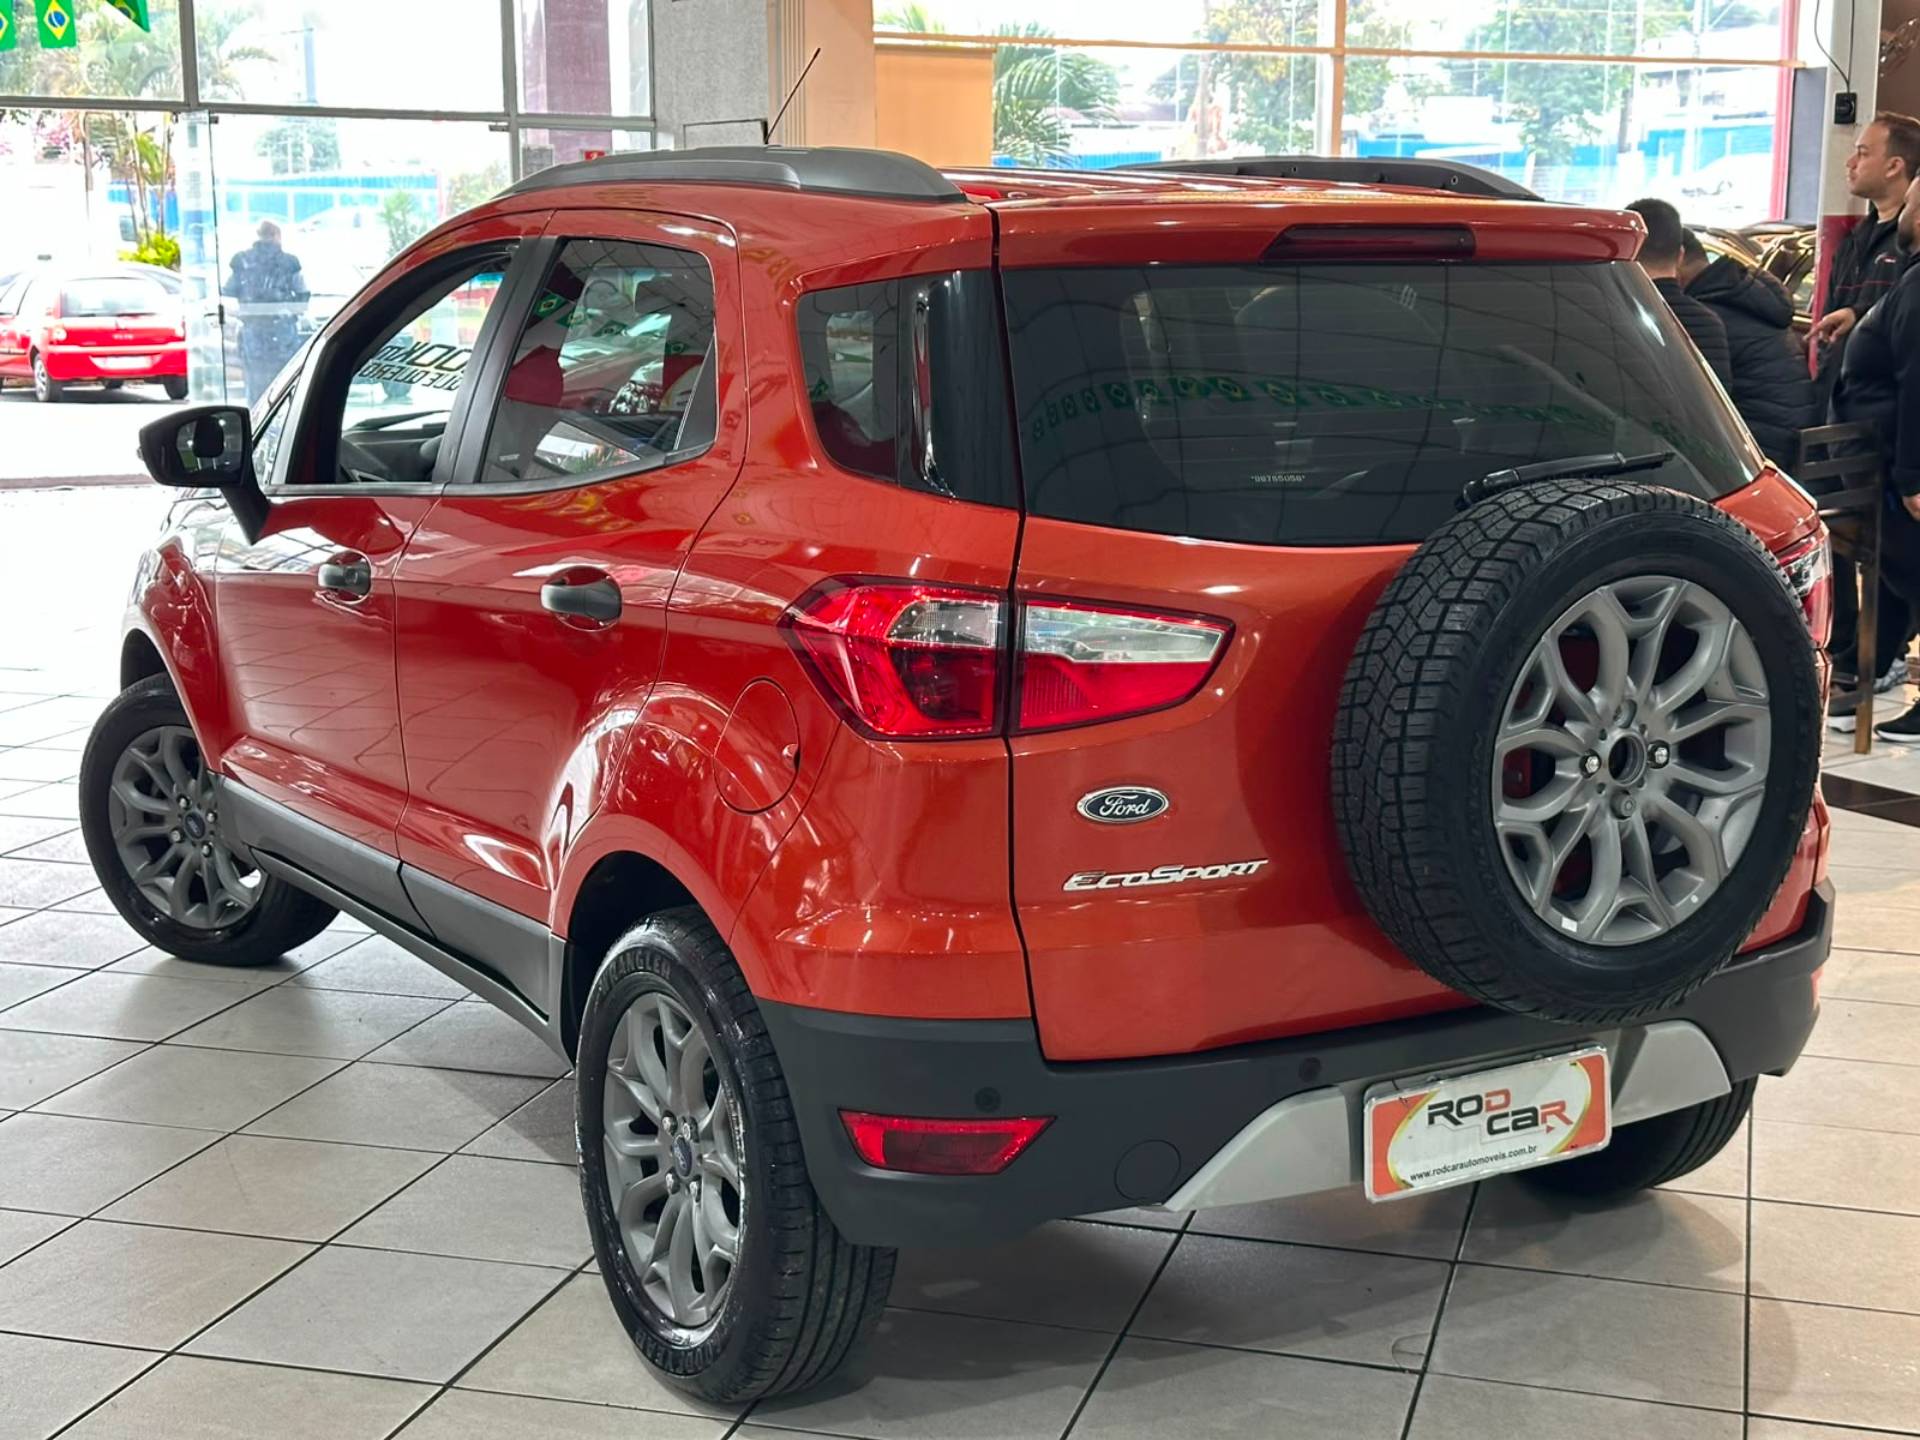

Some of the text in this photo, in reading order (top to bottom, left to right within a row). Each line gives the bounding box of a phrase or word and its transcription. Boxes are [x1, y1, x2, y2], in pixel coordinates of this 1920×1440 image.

[1099, 794, 1150, 817] Ford
[1428, 1088, 1511, 1126] ROD
[1409, 1144, 1538, 1182] www.rodcarautomoveis.com.br
